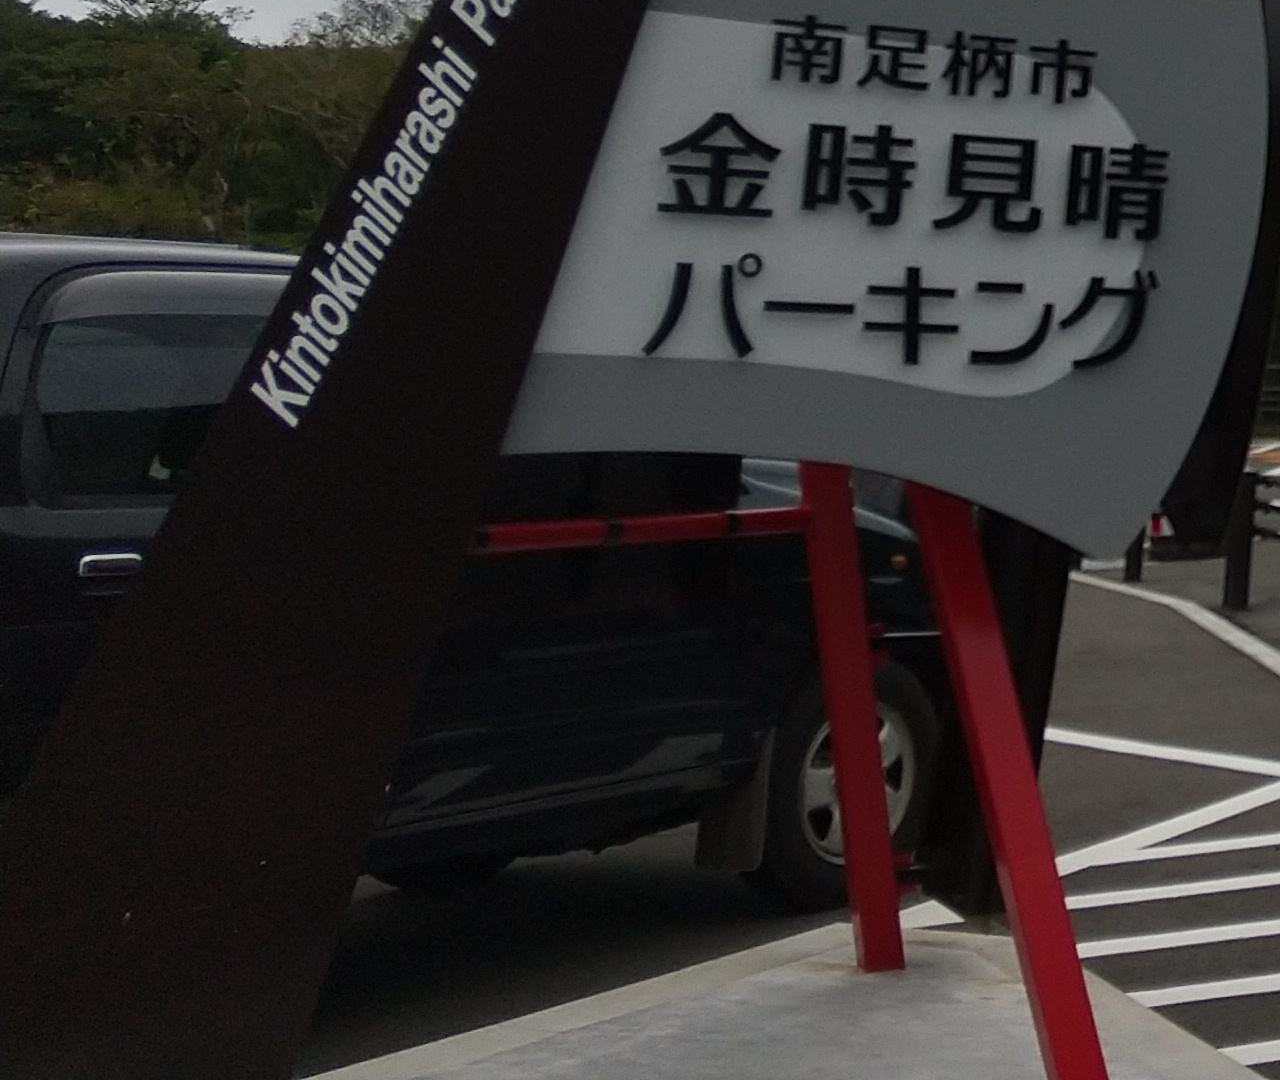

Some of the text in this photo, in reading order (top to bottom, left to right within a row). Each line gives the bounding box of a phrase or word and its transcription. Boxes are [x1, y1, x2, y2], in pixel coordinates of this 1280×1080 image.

[770, 15, 1098, 104] 南足柄市
[251, 36, 478, 428] Kintokimiharashi
[657, 112, 1170, 241] 金時見晴
[642, 253, 1160, 370] パーキング
